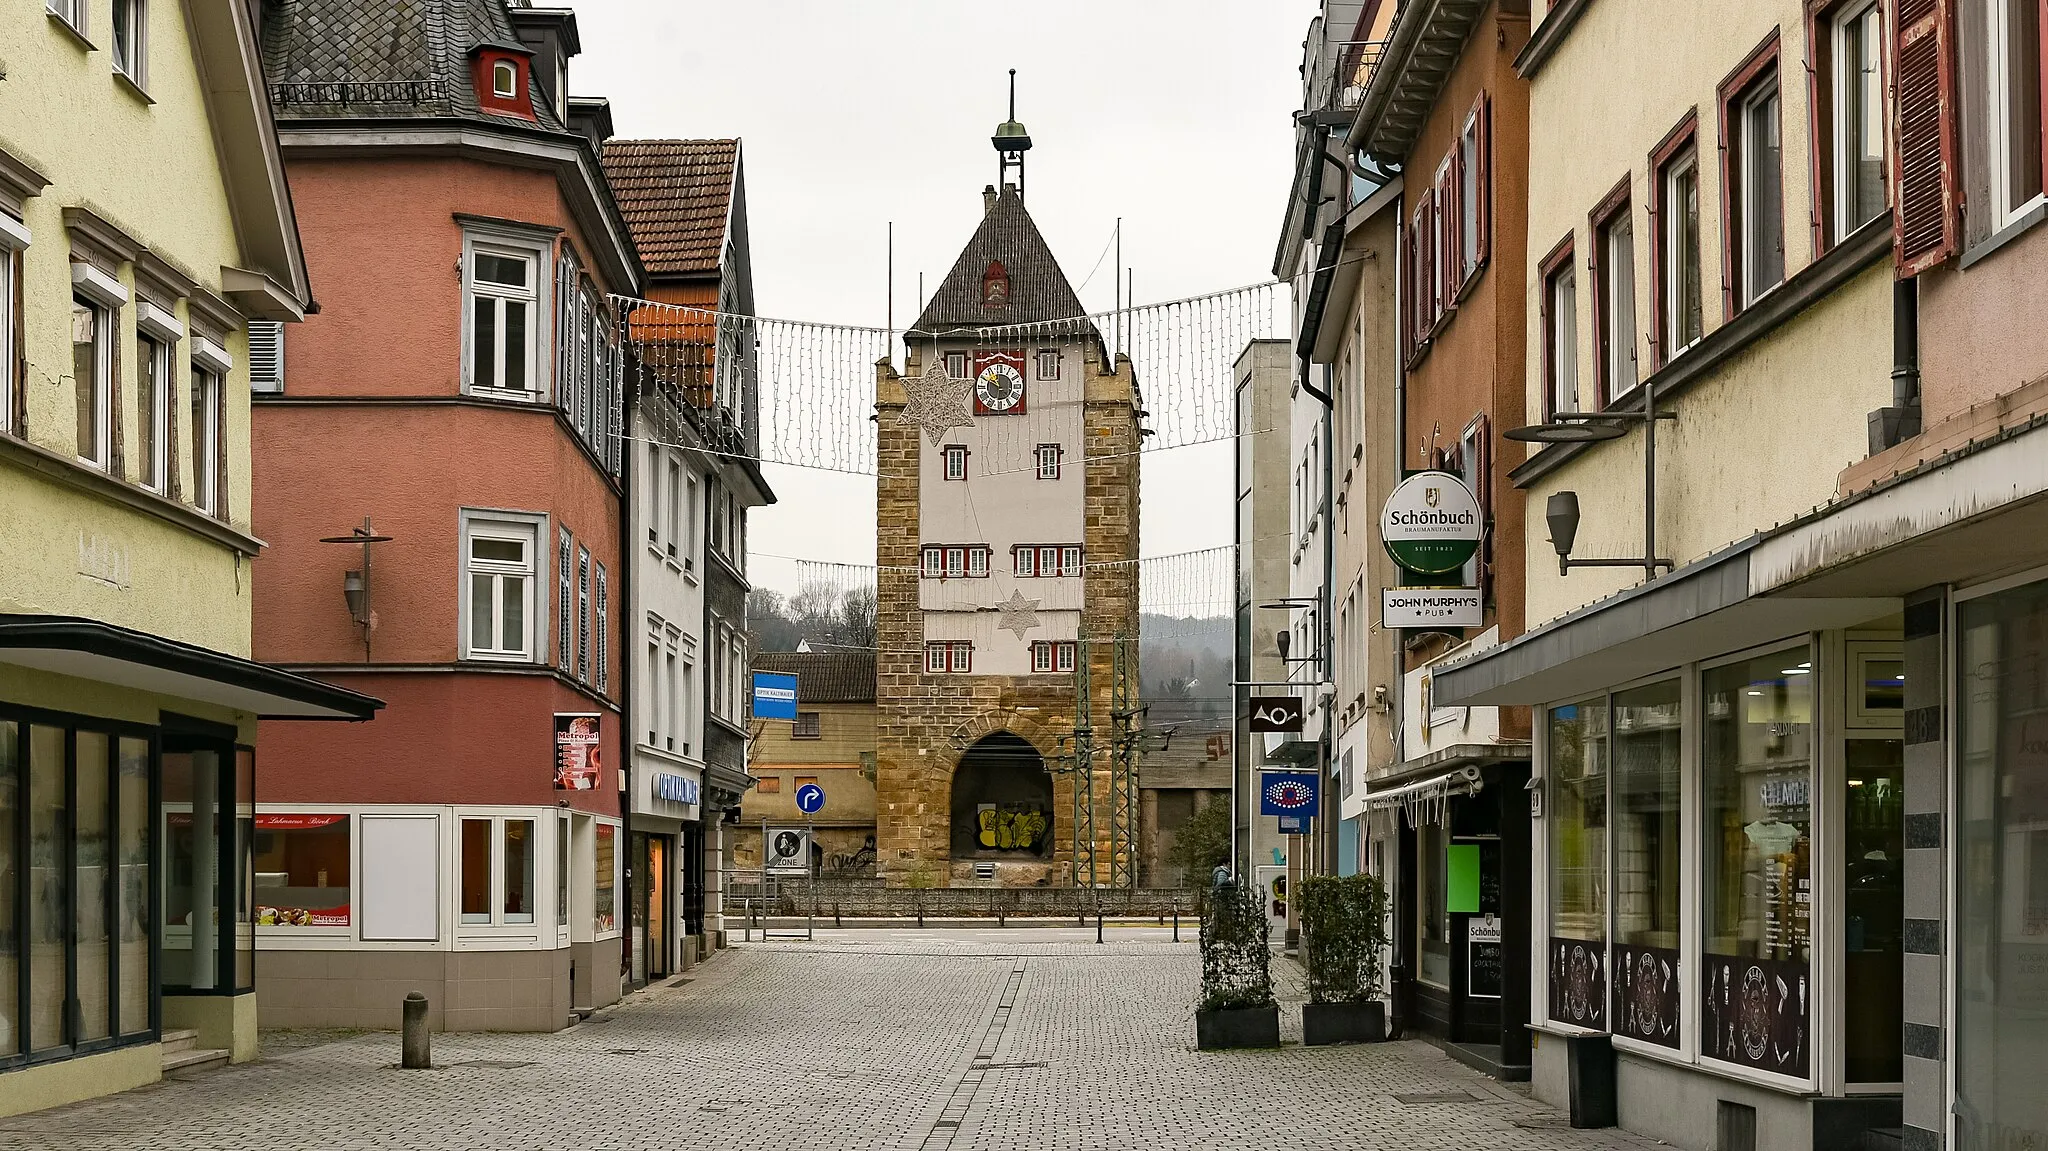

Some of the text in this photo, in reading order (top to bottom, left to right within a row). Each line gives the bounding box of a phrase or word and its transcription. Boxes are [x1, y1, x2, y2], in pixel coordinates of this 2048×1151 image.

[1390, 509, 1474, 525] Schönbuch
[1388, 597, 1478, 608] JOHN MURPHY'S
[1424, 609, 1445, 617] PUB
[558, 732, 599, 741] Metropol
[268, 816, 303, 824] Lahmacun
[307, 817, 331, 825] Börek
[312, 914, 348, 922] Metropol
